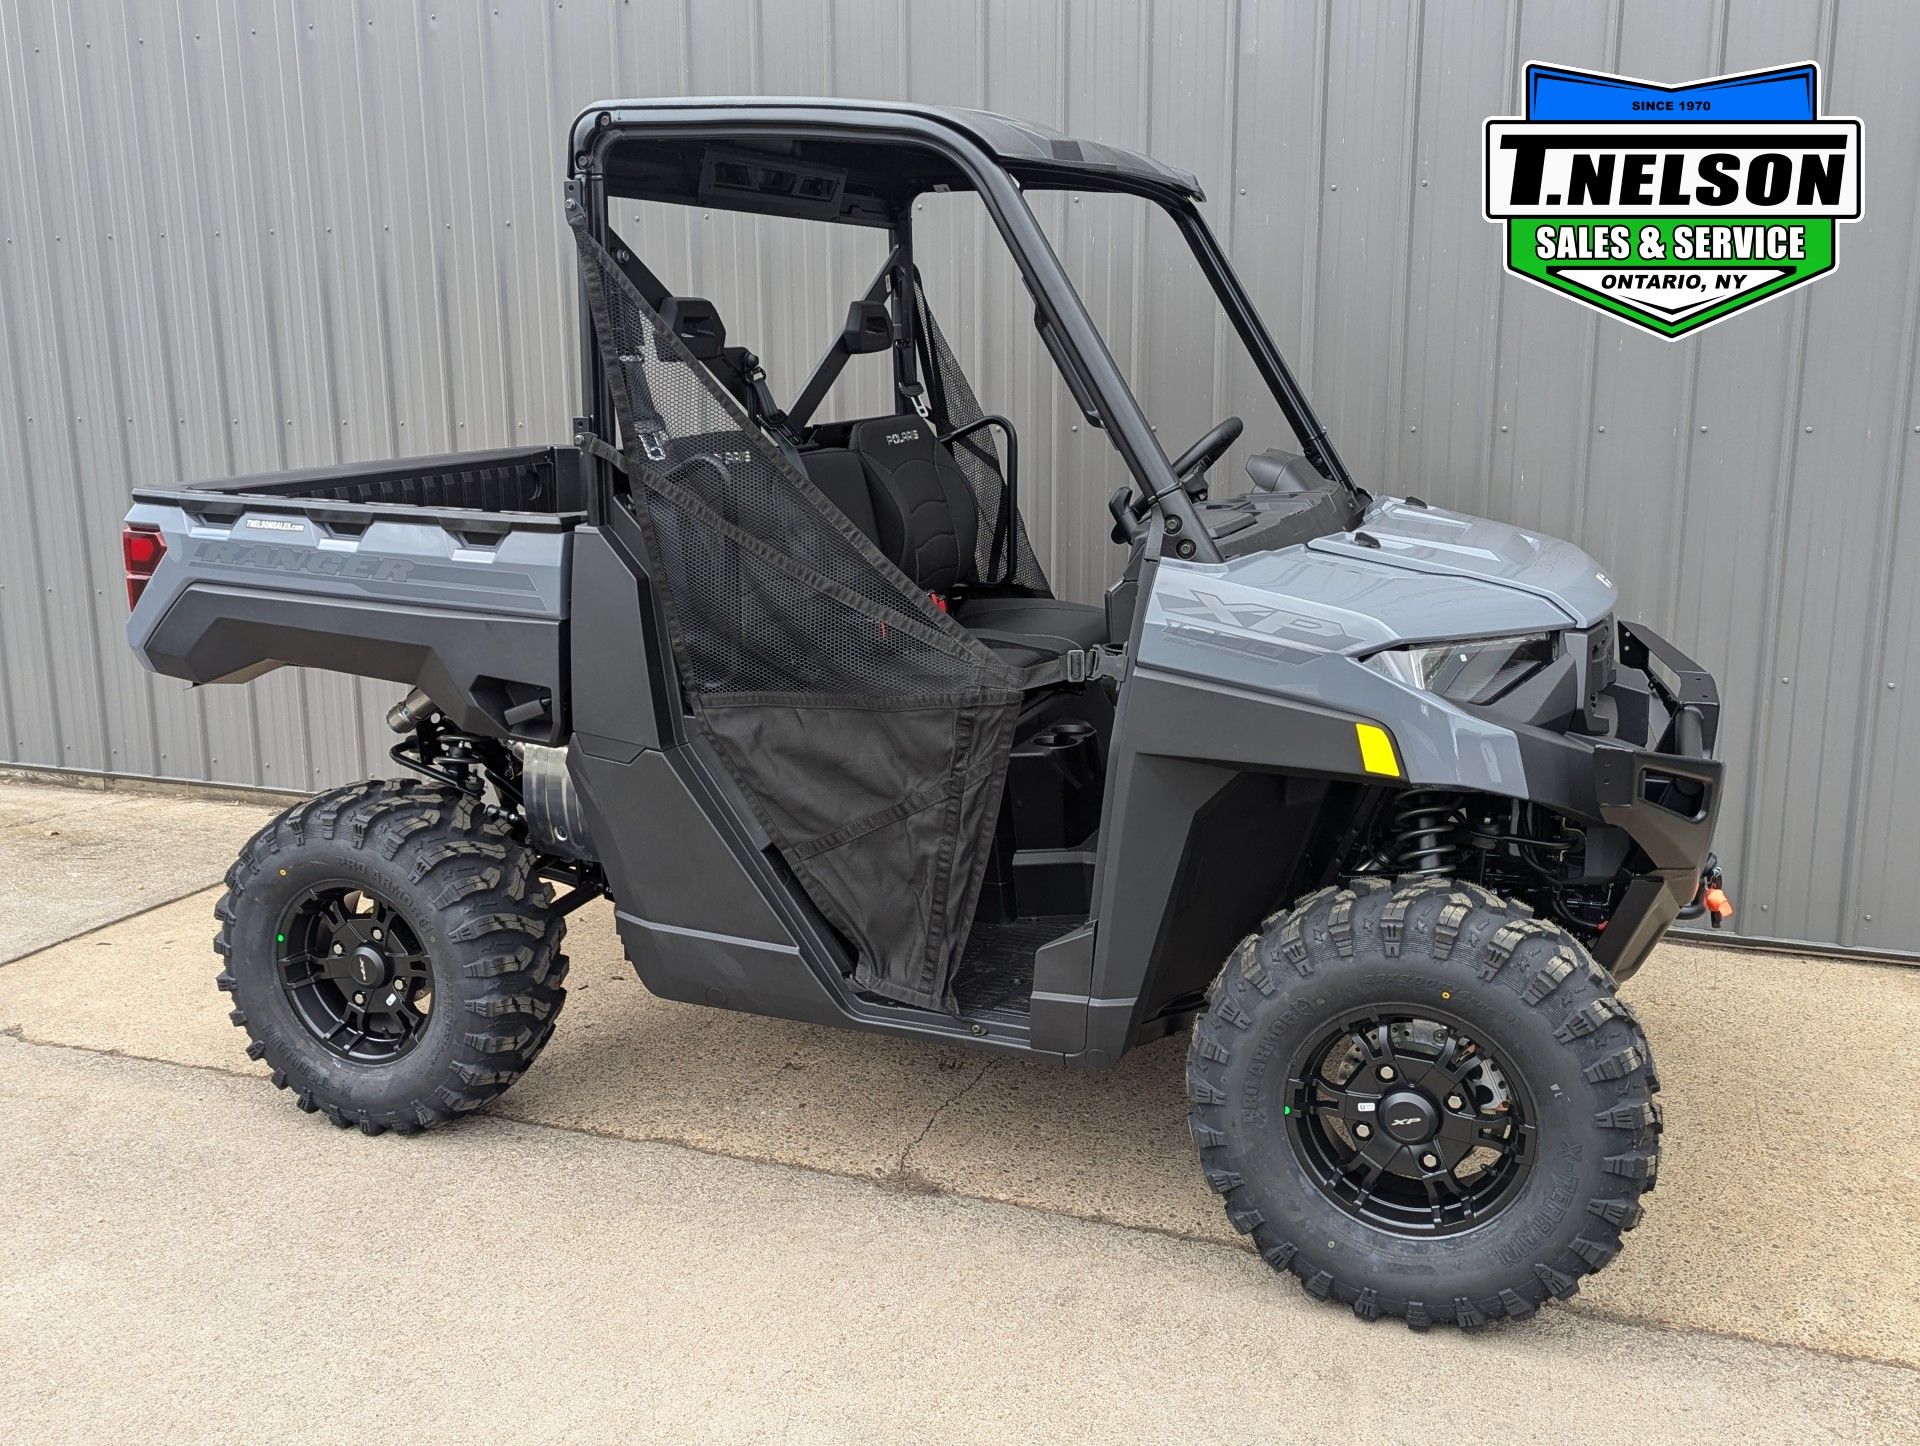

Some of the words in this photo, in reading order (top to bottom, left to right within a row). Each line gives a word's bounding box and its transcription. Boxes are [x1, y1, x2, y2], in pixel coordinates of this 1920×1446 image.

[886, 430, 919, 445] POLARIS
[202, 542, 416, 583] RANGER
[1163, 589, 1347, 640] XP
[1391, 1117, 1421, 1126] XP
[1497, 1143, 1583, 1267] X-TERRAIN
